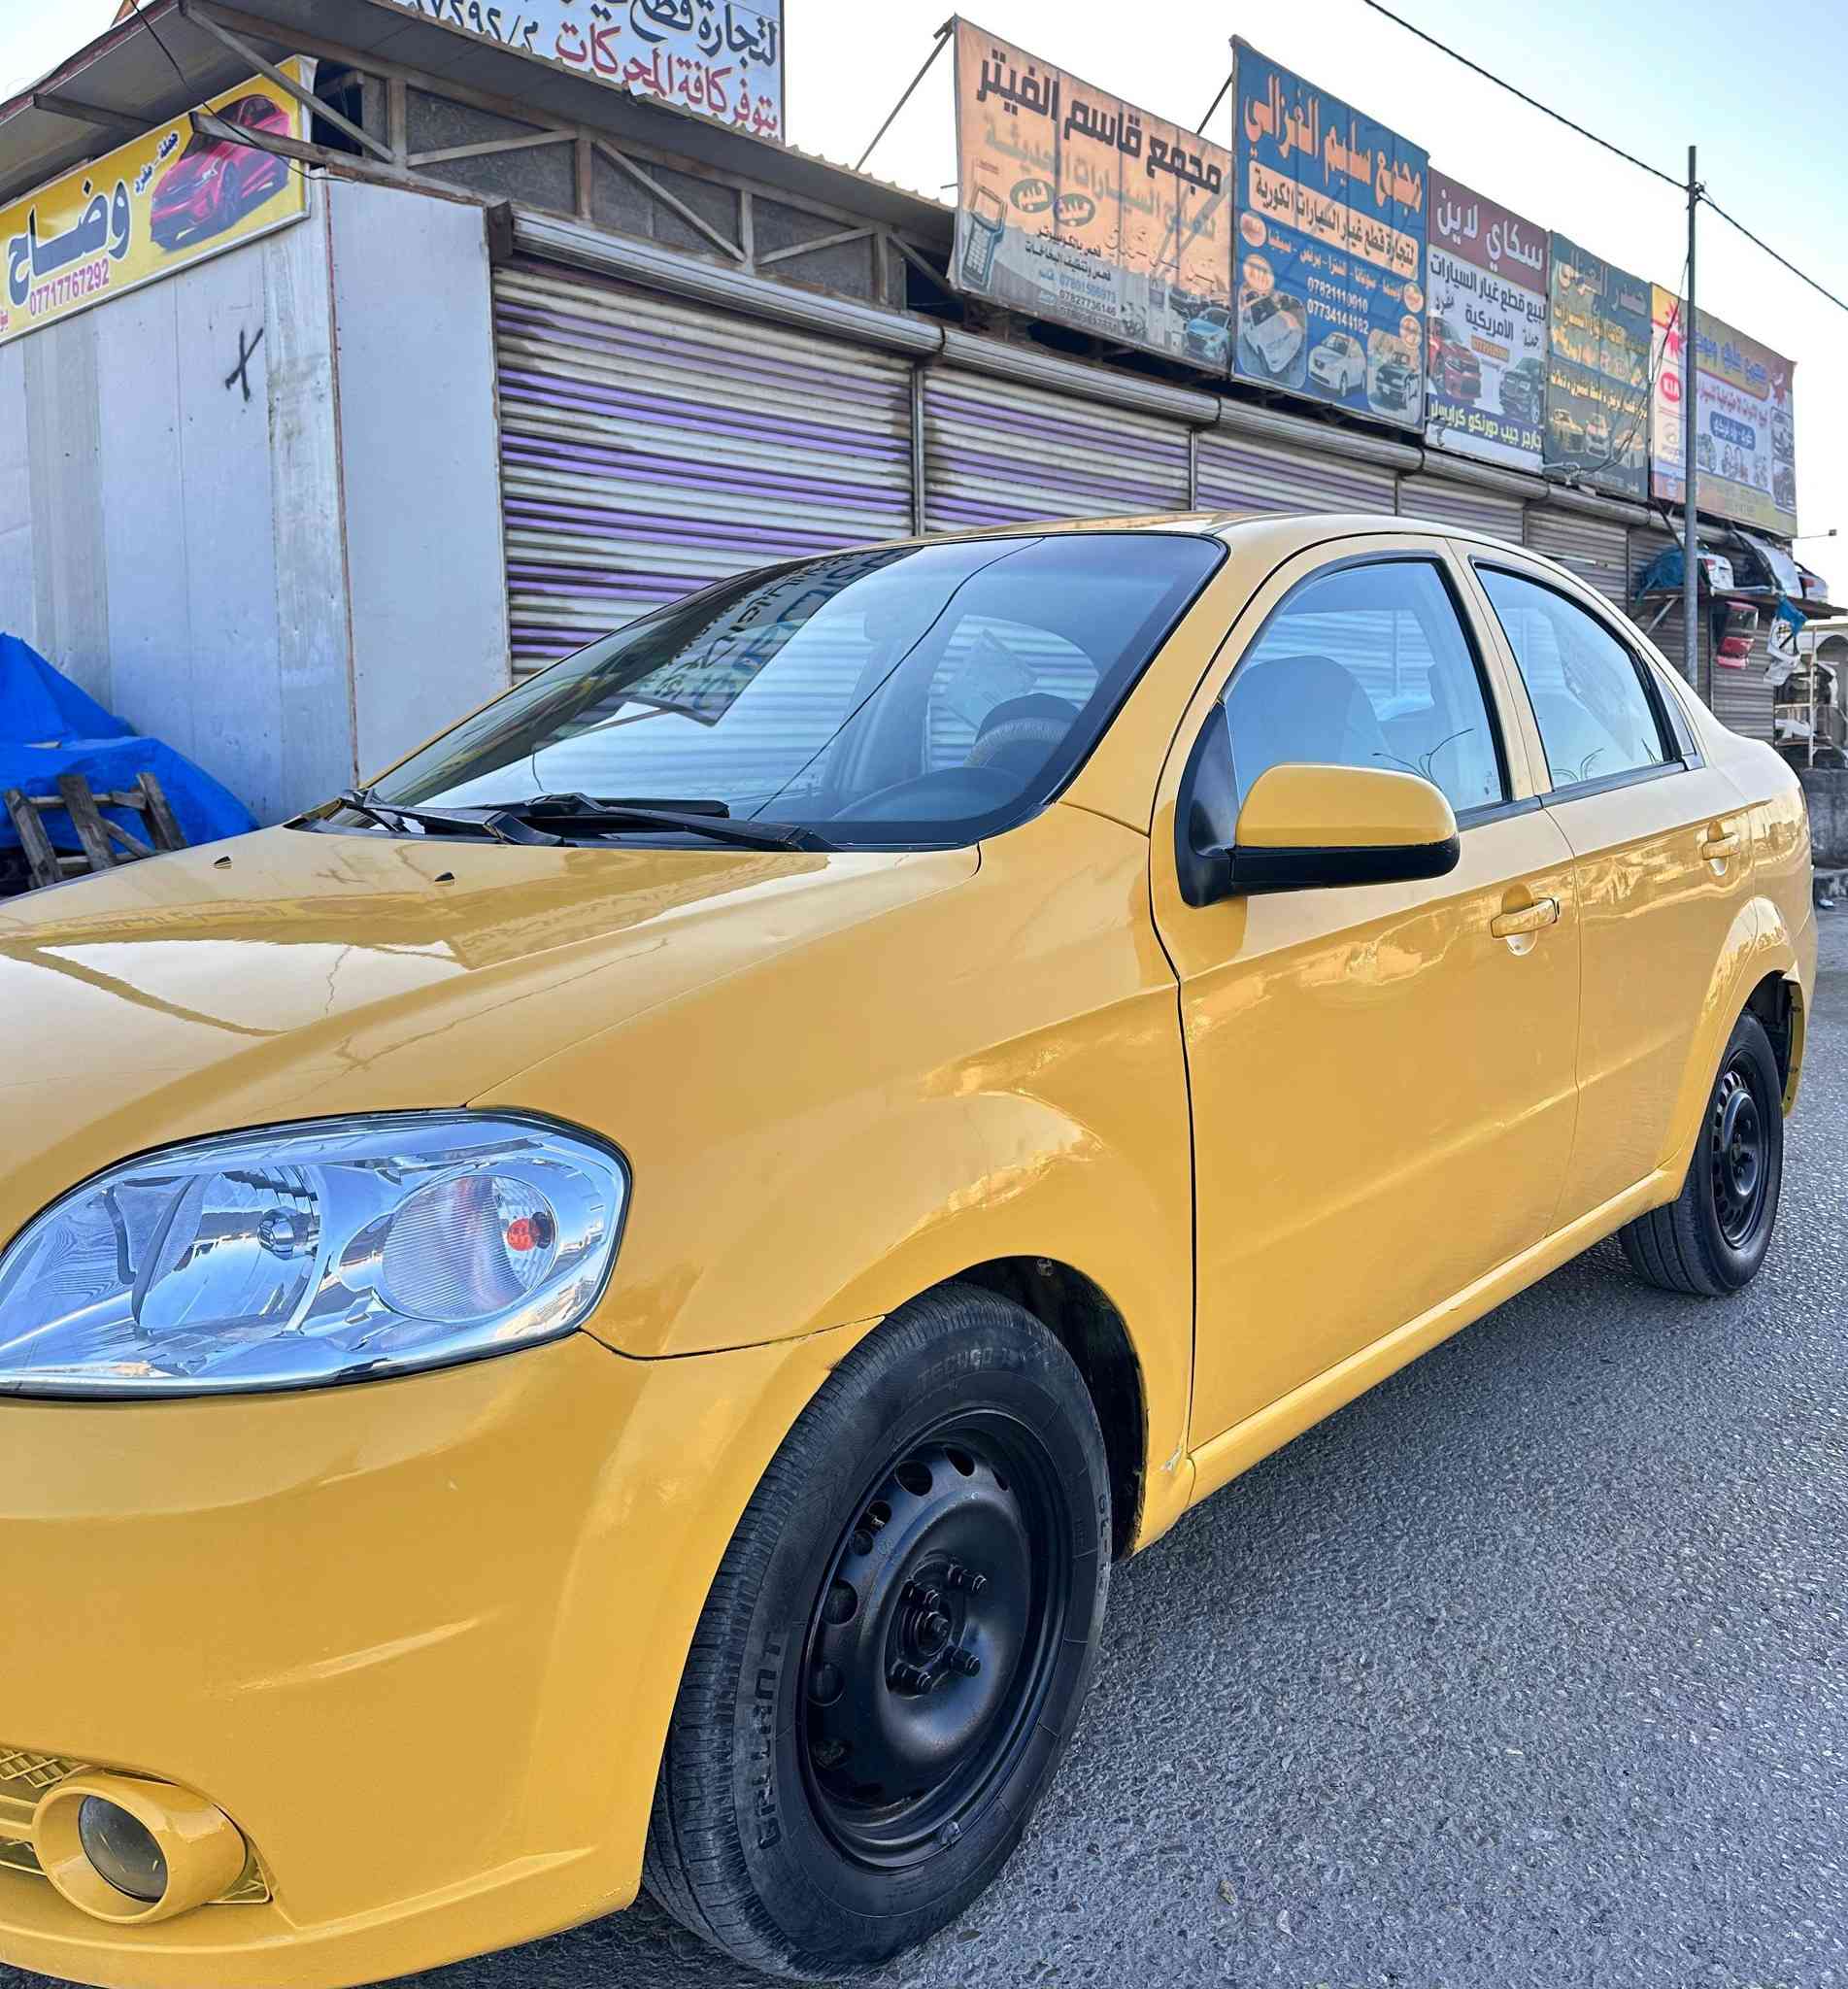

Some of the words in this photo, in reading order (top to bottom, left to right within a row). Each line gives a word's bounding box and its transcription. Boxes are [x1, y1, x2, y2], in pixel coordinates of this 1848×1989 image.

[679, 55, 732, 113] كافة
[977, 49, 1059, 122] الفيتر
[1064, 99, 1142, 158] قاسم
[1244, 74, 1320, 159] الغزالي
[1146, 135, 1222, 195] مجمع
[1325, 120, 1372, 187] سليم
[1375, 151, 1423, 217] مجمع
[8, 179, 131, 307] وضاح
[1437, 188, 1478, 245] لاين
[1486, 219, 1543, 272] سكاي
[29, 257, 110, 316] 07717767292
[1430, 253, 1477, 291] السيارات
[1479, 277, 1499, 303] غيار
[1500, 287, 1525, 313] قطع
[1465, 302, 1514, 341] الامريكية
